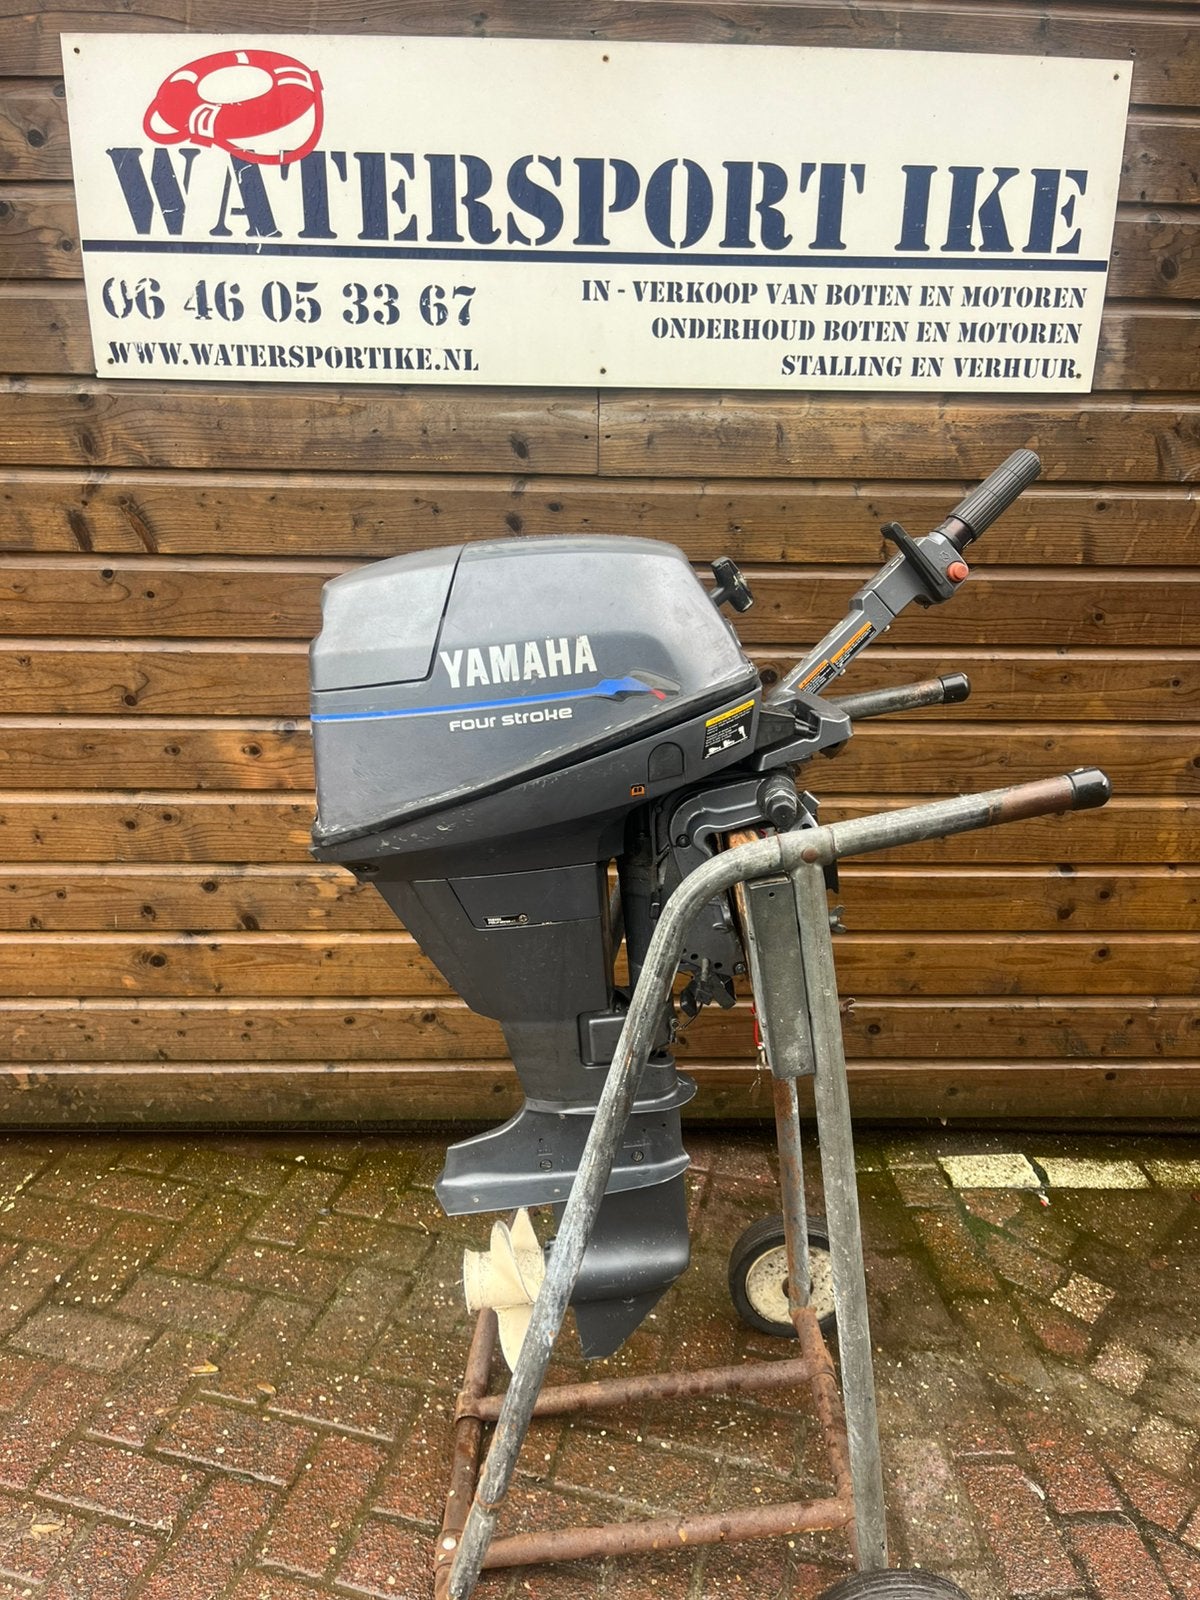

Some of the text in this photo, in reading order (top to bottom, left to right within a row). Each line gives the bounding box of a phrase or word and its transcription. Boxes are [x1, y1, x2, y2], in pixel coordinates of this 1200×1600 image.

[105, 148, 1088, 254] WATERSPORT IKE
[102, 277, 476, 326] 06 46 05 33 67
[582, 280, 611, 301] IN
[632, 281, 758, 304] VERKOOP
[766, 283, 818, 305] VAN
[825, 284, 912, 306] BOTEN
[920, 285, 952, 307] EN
[962, 286, 1088, 308] MOTOREN
[652, 317, 1082, 344] ONDERHOUD BOTEN EN MOTOREN
[109, 341, 479, 371] WWW.WATERSPORTIKE.NL
[781, 355, 902, 377] STALLING
[911, 357, 944, 378] EN
[439, 635, 598, 688] YAMAHA
